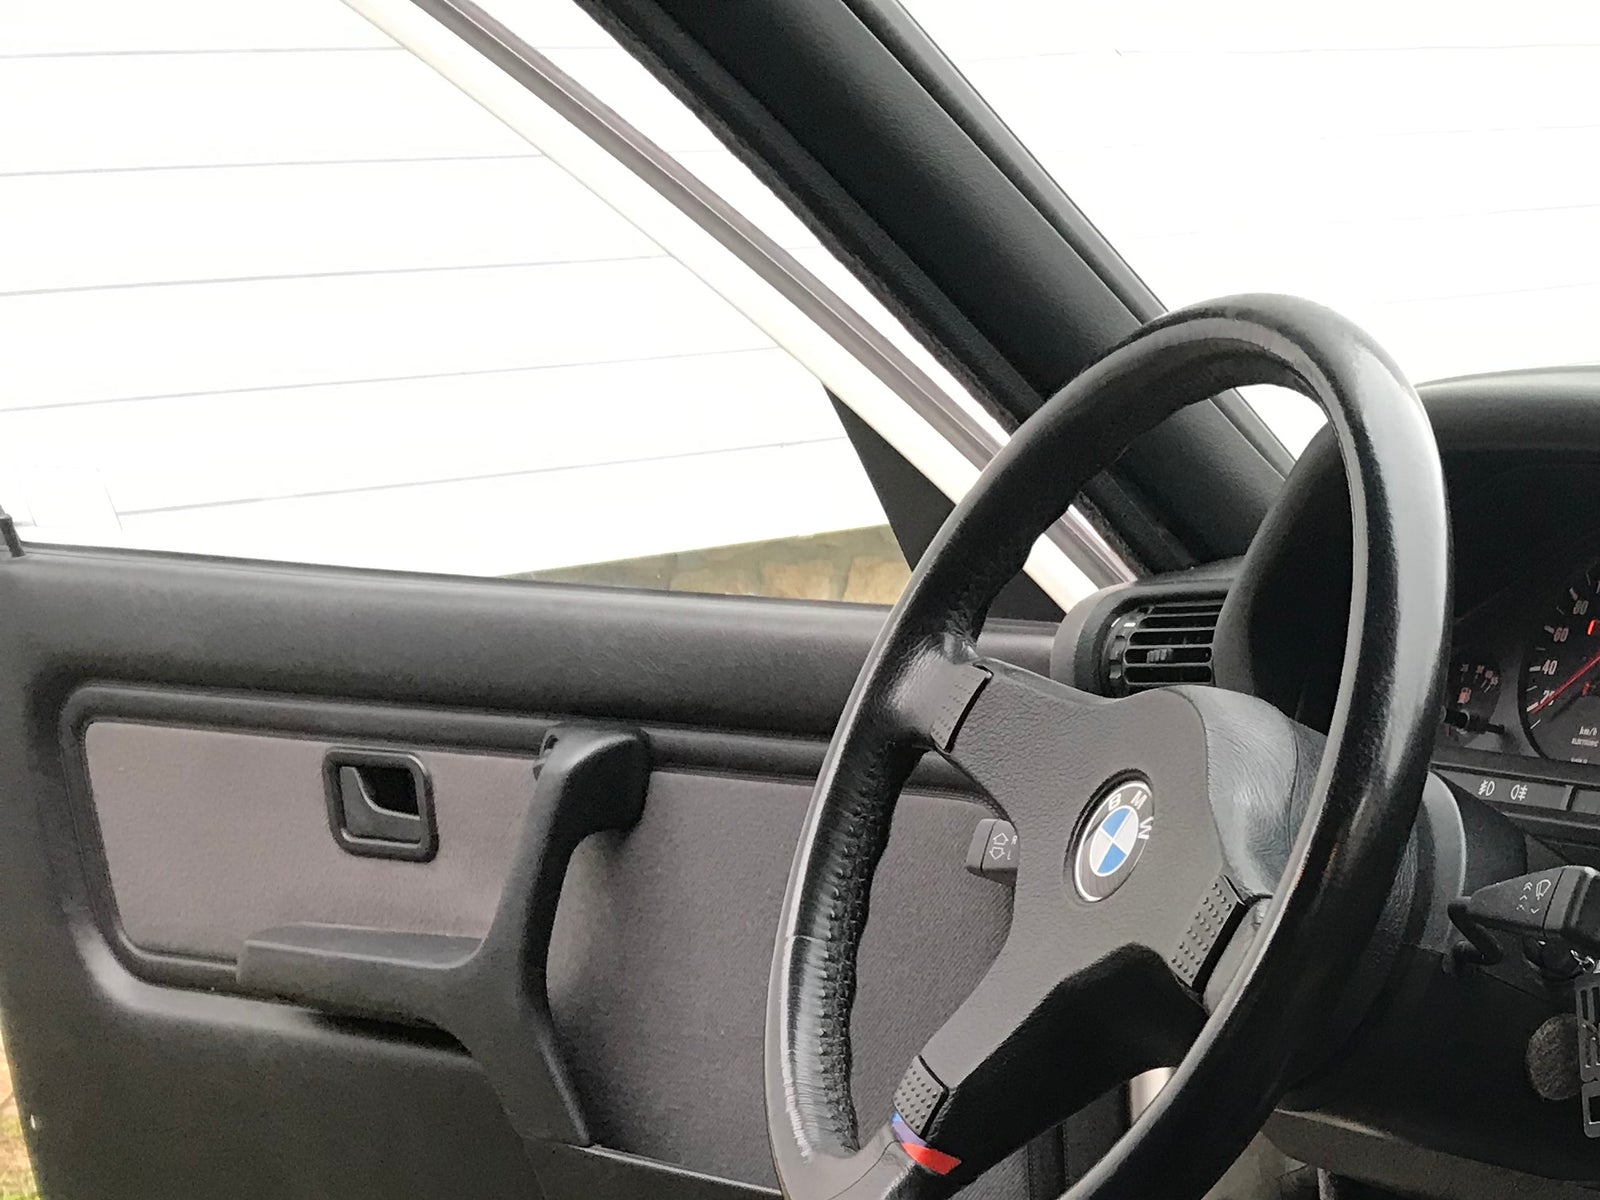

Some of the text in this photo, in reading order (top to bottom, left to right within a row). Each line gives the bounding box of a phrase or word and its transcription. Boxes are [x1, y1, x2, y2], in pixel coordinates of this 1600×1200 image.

[1573, 600, 1589, 615] 80
[1553, 627, 1569, 642] 60
[1541, 659, 1558, 675] 40
[1108, 790, 1154, 840] BMW
